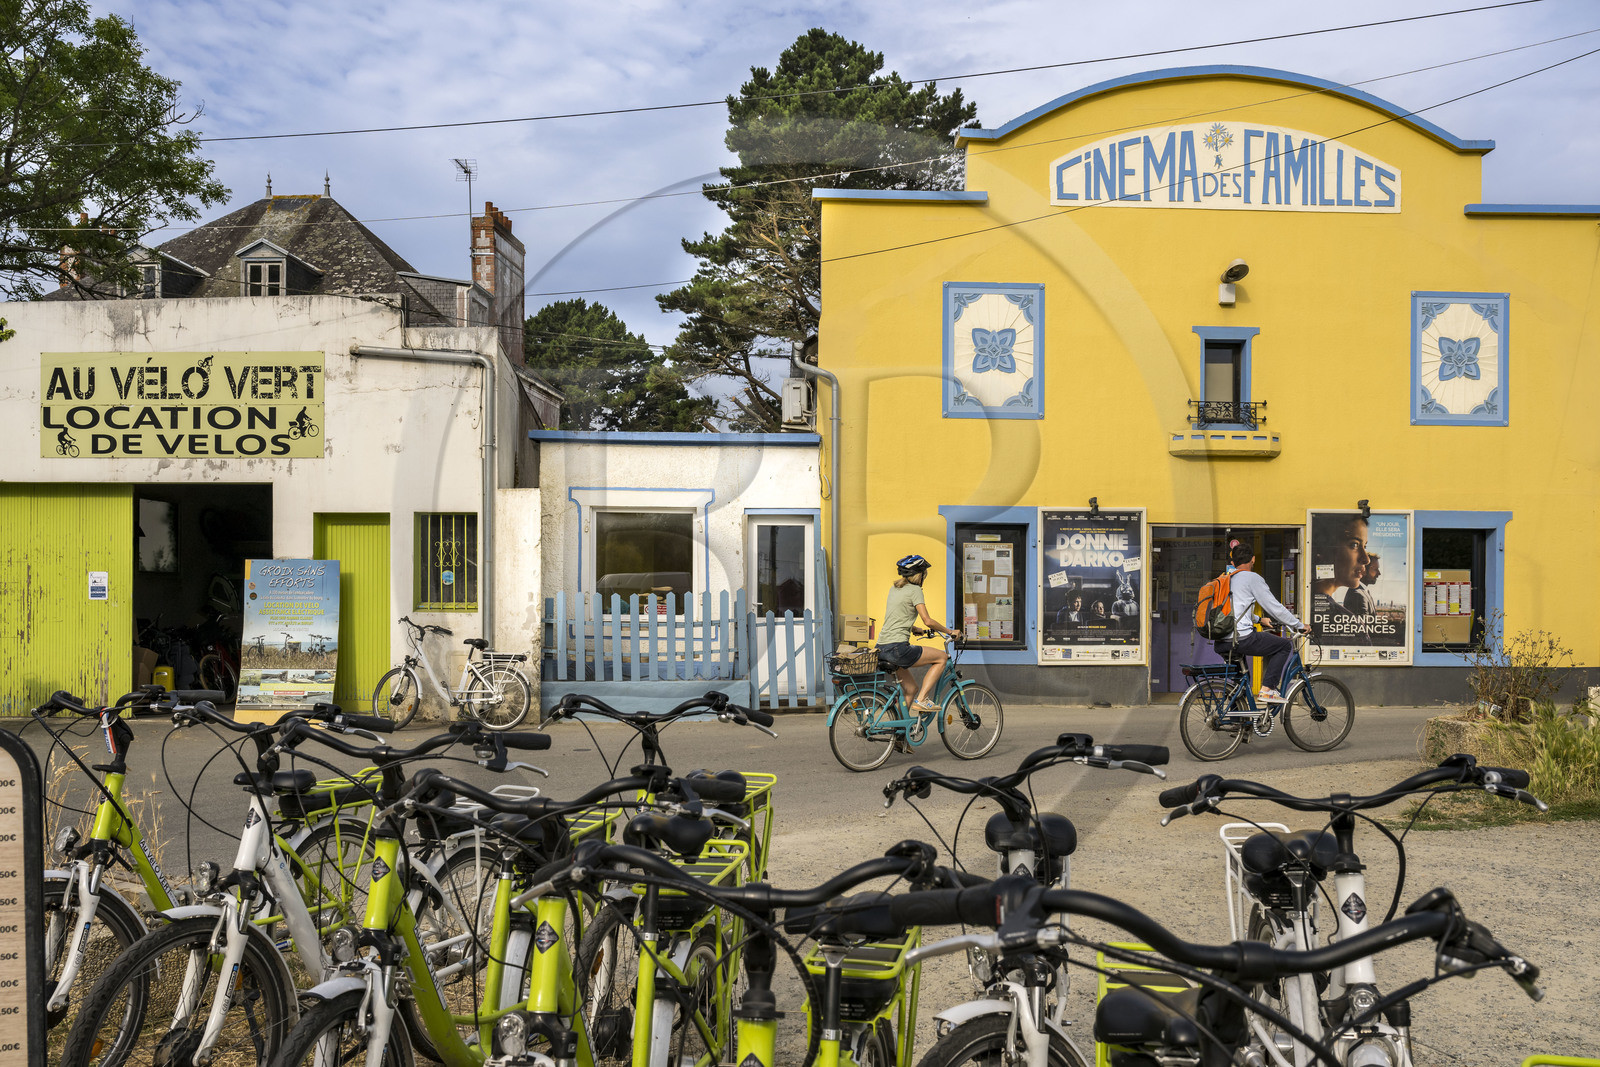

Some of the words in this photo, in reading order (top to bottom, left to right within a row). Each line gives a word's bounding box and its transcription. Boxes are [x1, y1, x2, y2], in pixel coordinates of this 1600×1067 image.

[1203, 172, 1242, 197] DES
[1244, 129, 1396, 208] FAMILLES
[46, 366, 96, 400] AU
[110, 356, 210, 400] VÉLO
[224, 365, 322, 400] VERT
[43, 405, 277, 430] LOCATION
[92, 434, 143, 455] DE
[156, 433, 291, 456] VELOS
[1056, 533, 1129, 550] DONNIE
[1060, 550, 1124, 568] DARKO
[296, 564, 326, 576] SANS
[269, 578, 315, 588] EFFORTS
[1314, 614, 1330, 623] DE
[1334, 614, 1388, 624] GRANDES
[1322, 622, 1396, 634] ESPÉRANCES
